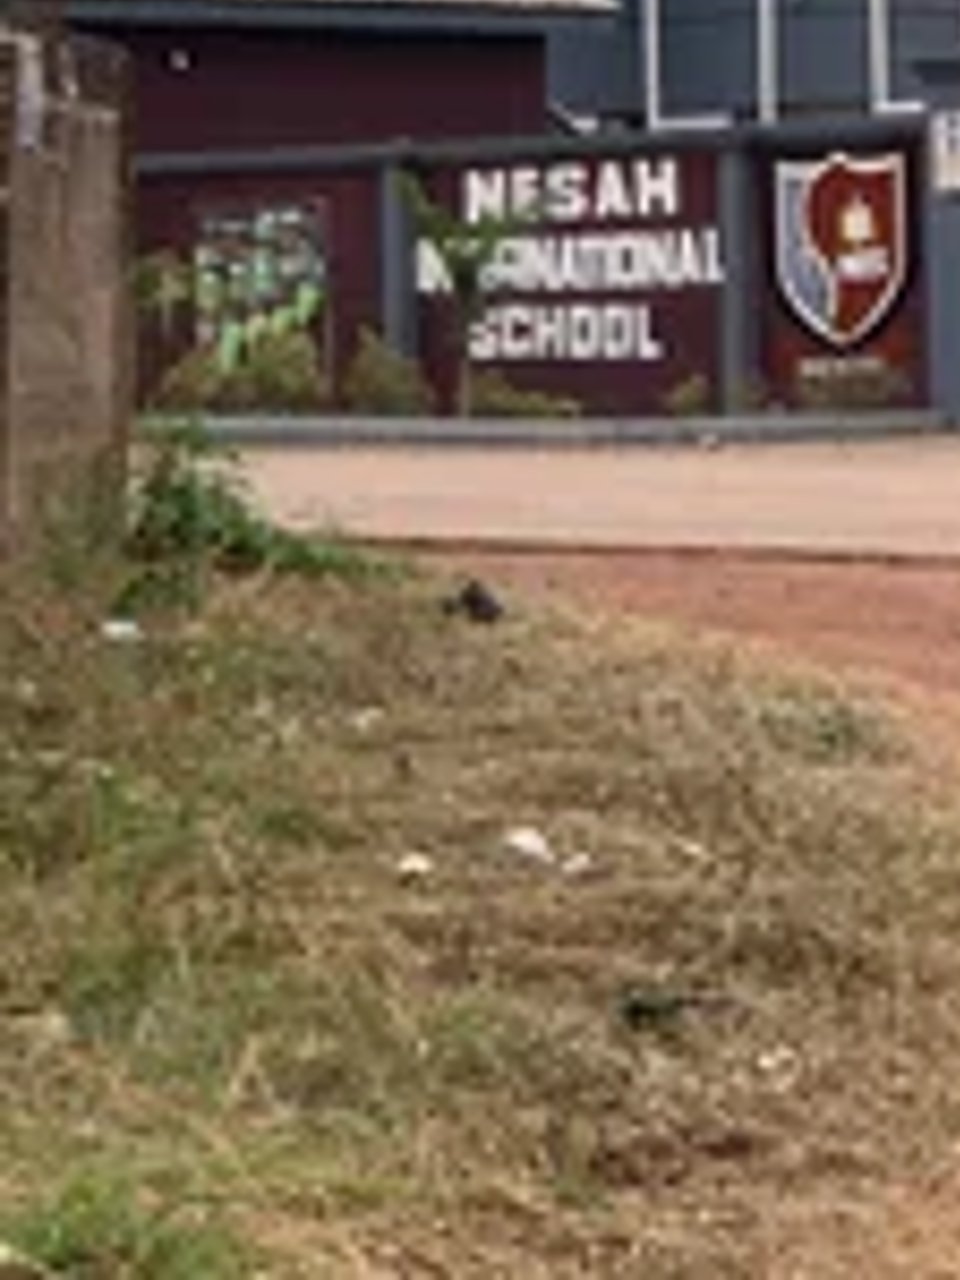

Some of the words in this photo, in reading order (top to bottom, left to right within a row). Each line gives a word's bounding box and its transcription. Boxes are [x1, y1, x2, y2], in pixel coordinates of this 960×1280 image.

[466, 160, 677, 222] NESAH
[416, 229, 723, 292] INRNATIONAL
[469, 306, 661, 360] SCHOOL
